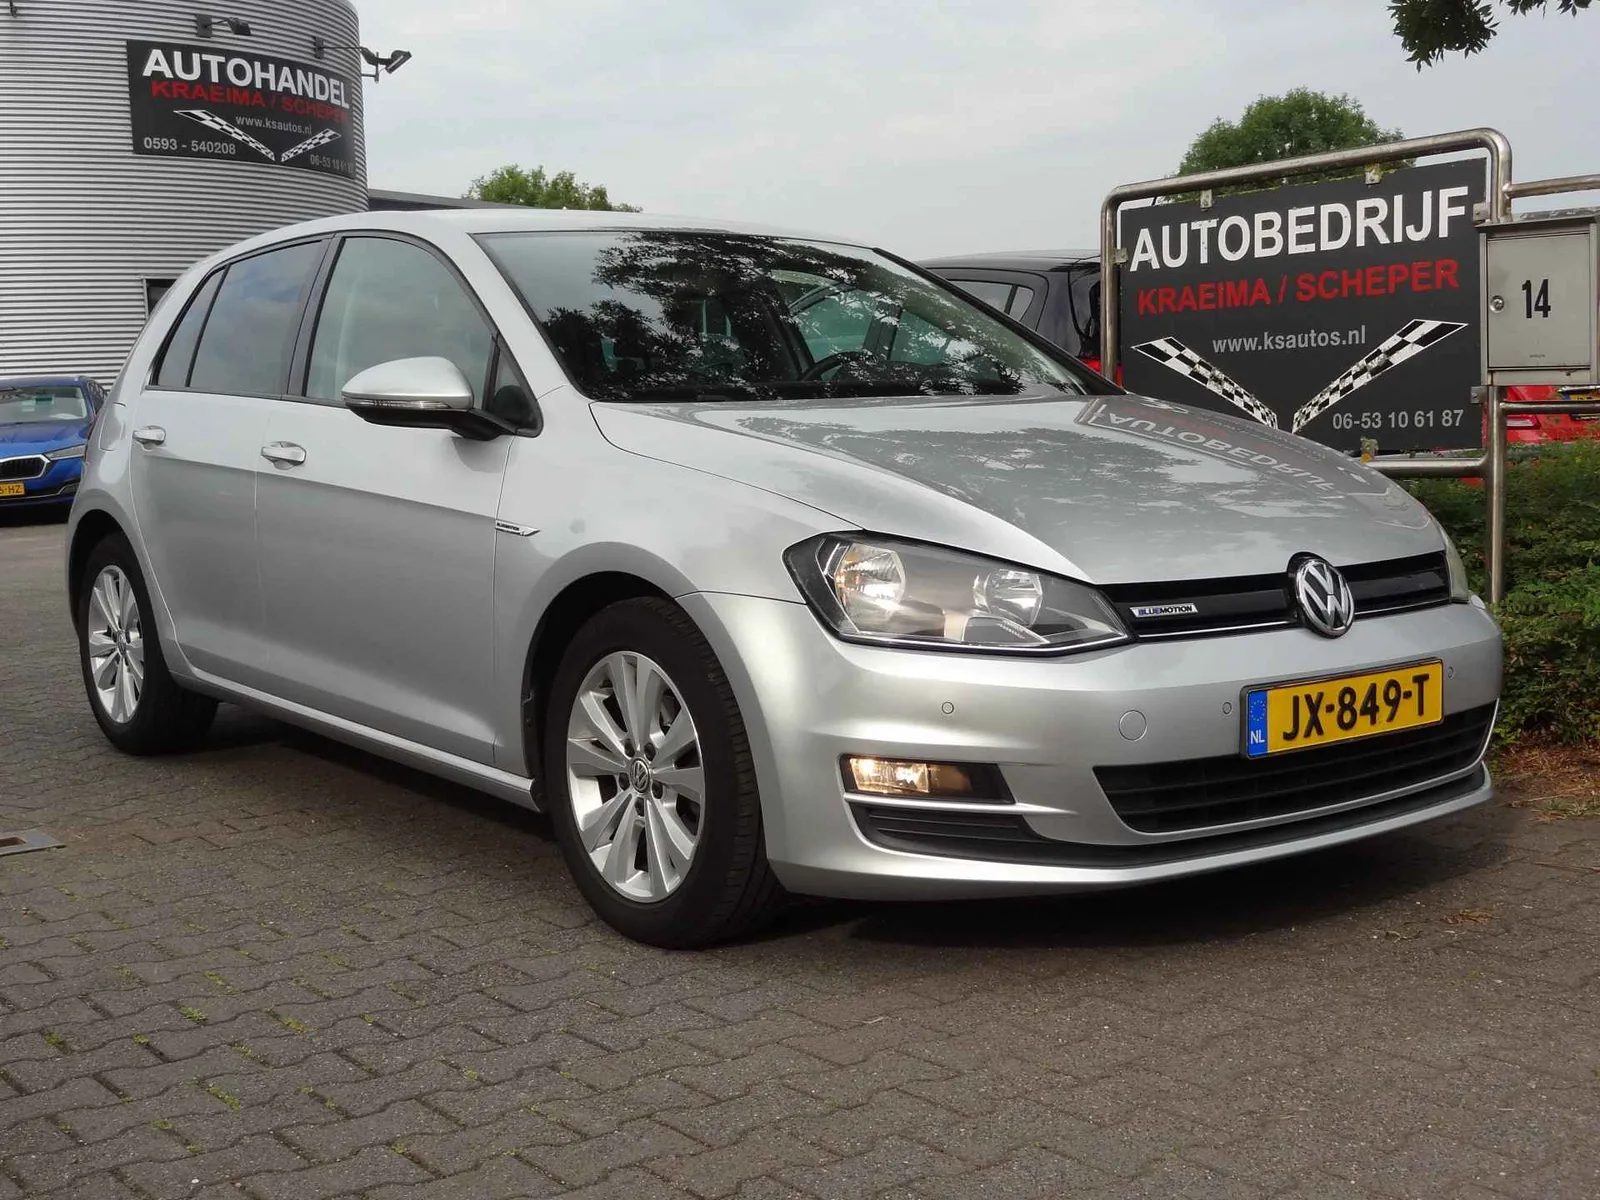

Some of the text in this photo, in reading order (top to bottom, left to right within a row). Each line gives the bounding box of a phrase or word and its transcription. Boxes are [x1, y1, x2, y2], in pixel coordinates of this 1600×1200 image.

[143, 49, 350, 109] AUTOHANDEL
[152, 80, 266, 108] KRAEIMA
[235, 115, 313, 134] www.ksautos.nl
[143, 136, 178, 150] 0593
[191, 140, 236, 155] 540208
[1130, 186, 1468, 273] AUTOBEDRIJF
[1137, 259, 1460, 317] KRAEIMA / SCHEPER
[1522, 278, 1552, 319] 14
[1212, 325, 1366, 354] www.ksautos.nl
[1332, 409, 1464, 431] 06-53 10 61 87
[1138, 605, 1193, 616] BLUEMOTION
[1282, 673, 1430, 741] JX-849-T
[1250, 730, 1265, 744] NL
